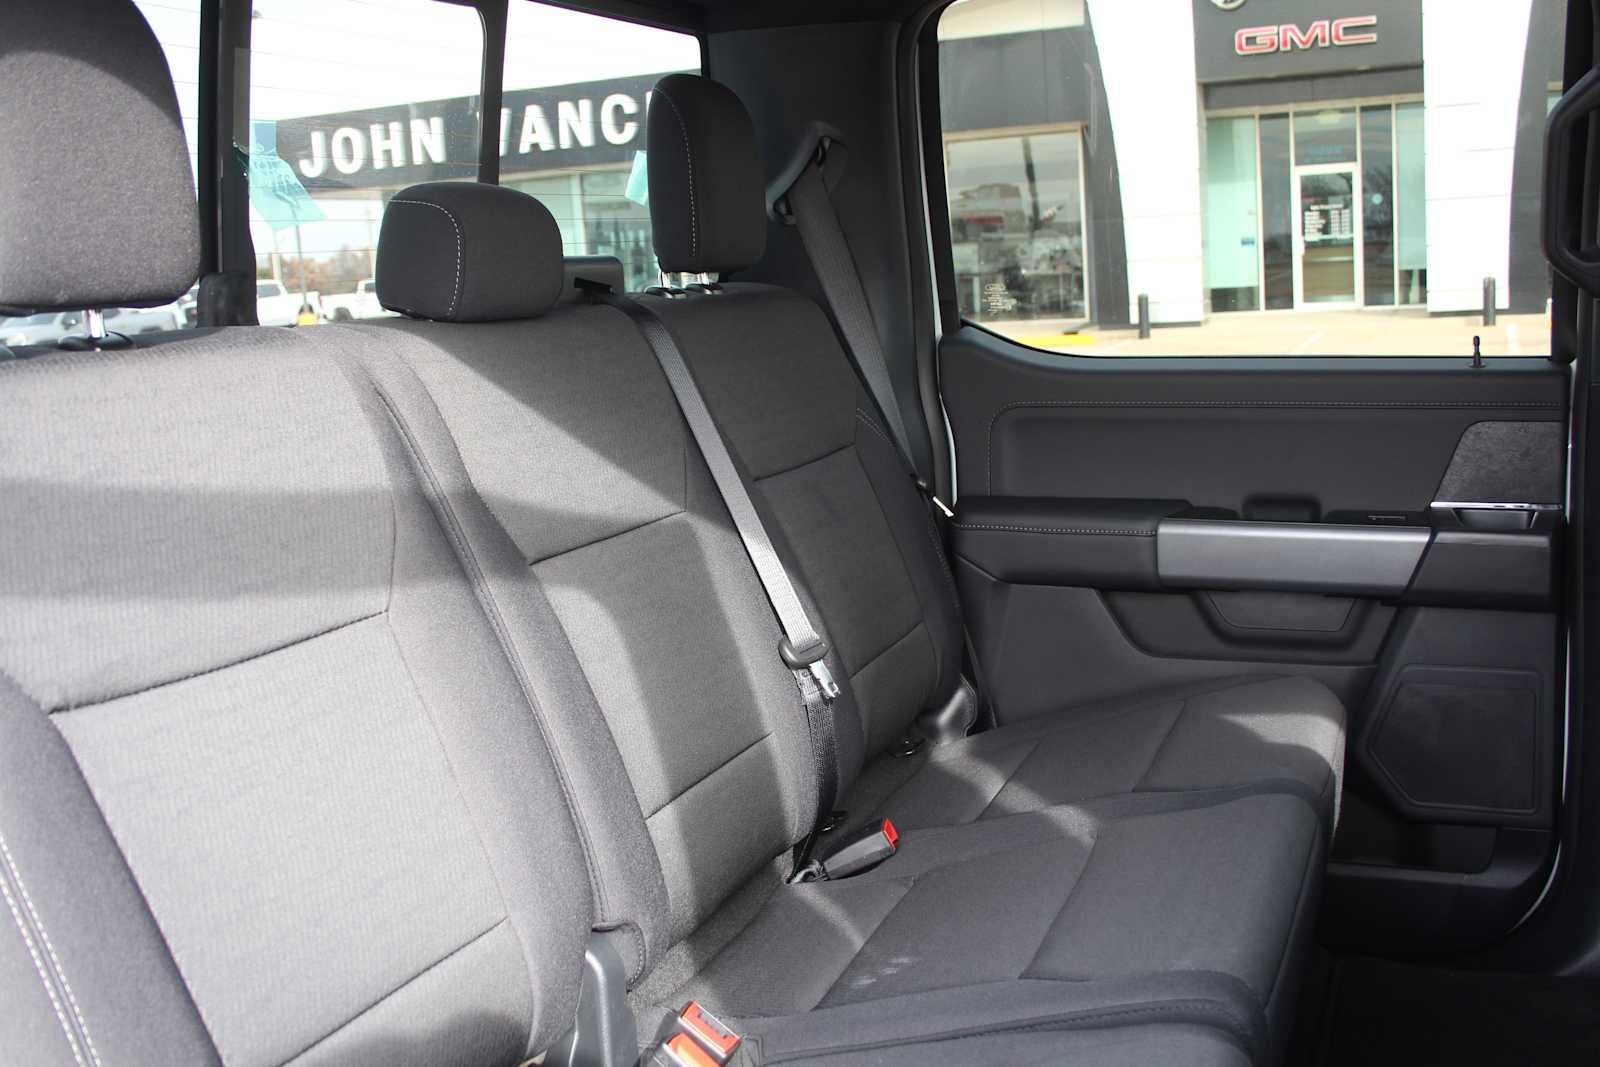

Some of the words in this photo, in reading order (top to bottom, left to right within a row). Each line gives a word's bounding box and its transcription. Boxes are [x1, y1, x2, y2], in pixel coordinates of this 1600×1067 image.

[1235, 15, 1377, 55] GMC
[299, 116, 447, 178] JOHN
[477, 91, 653, 157] ANC
